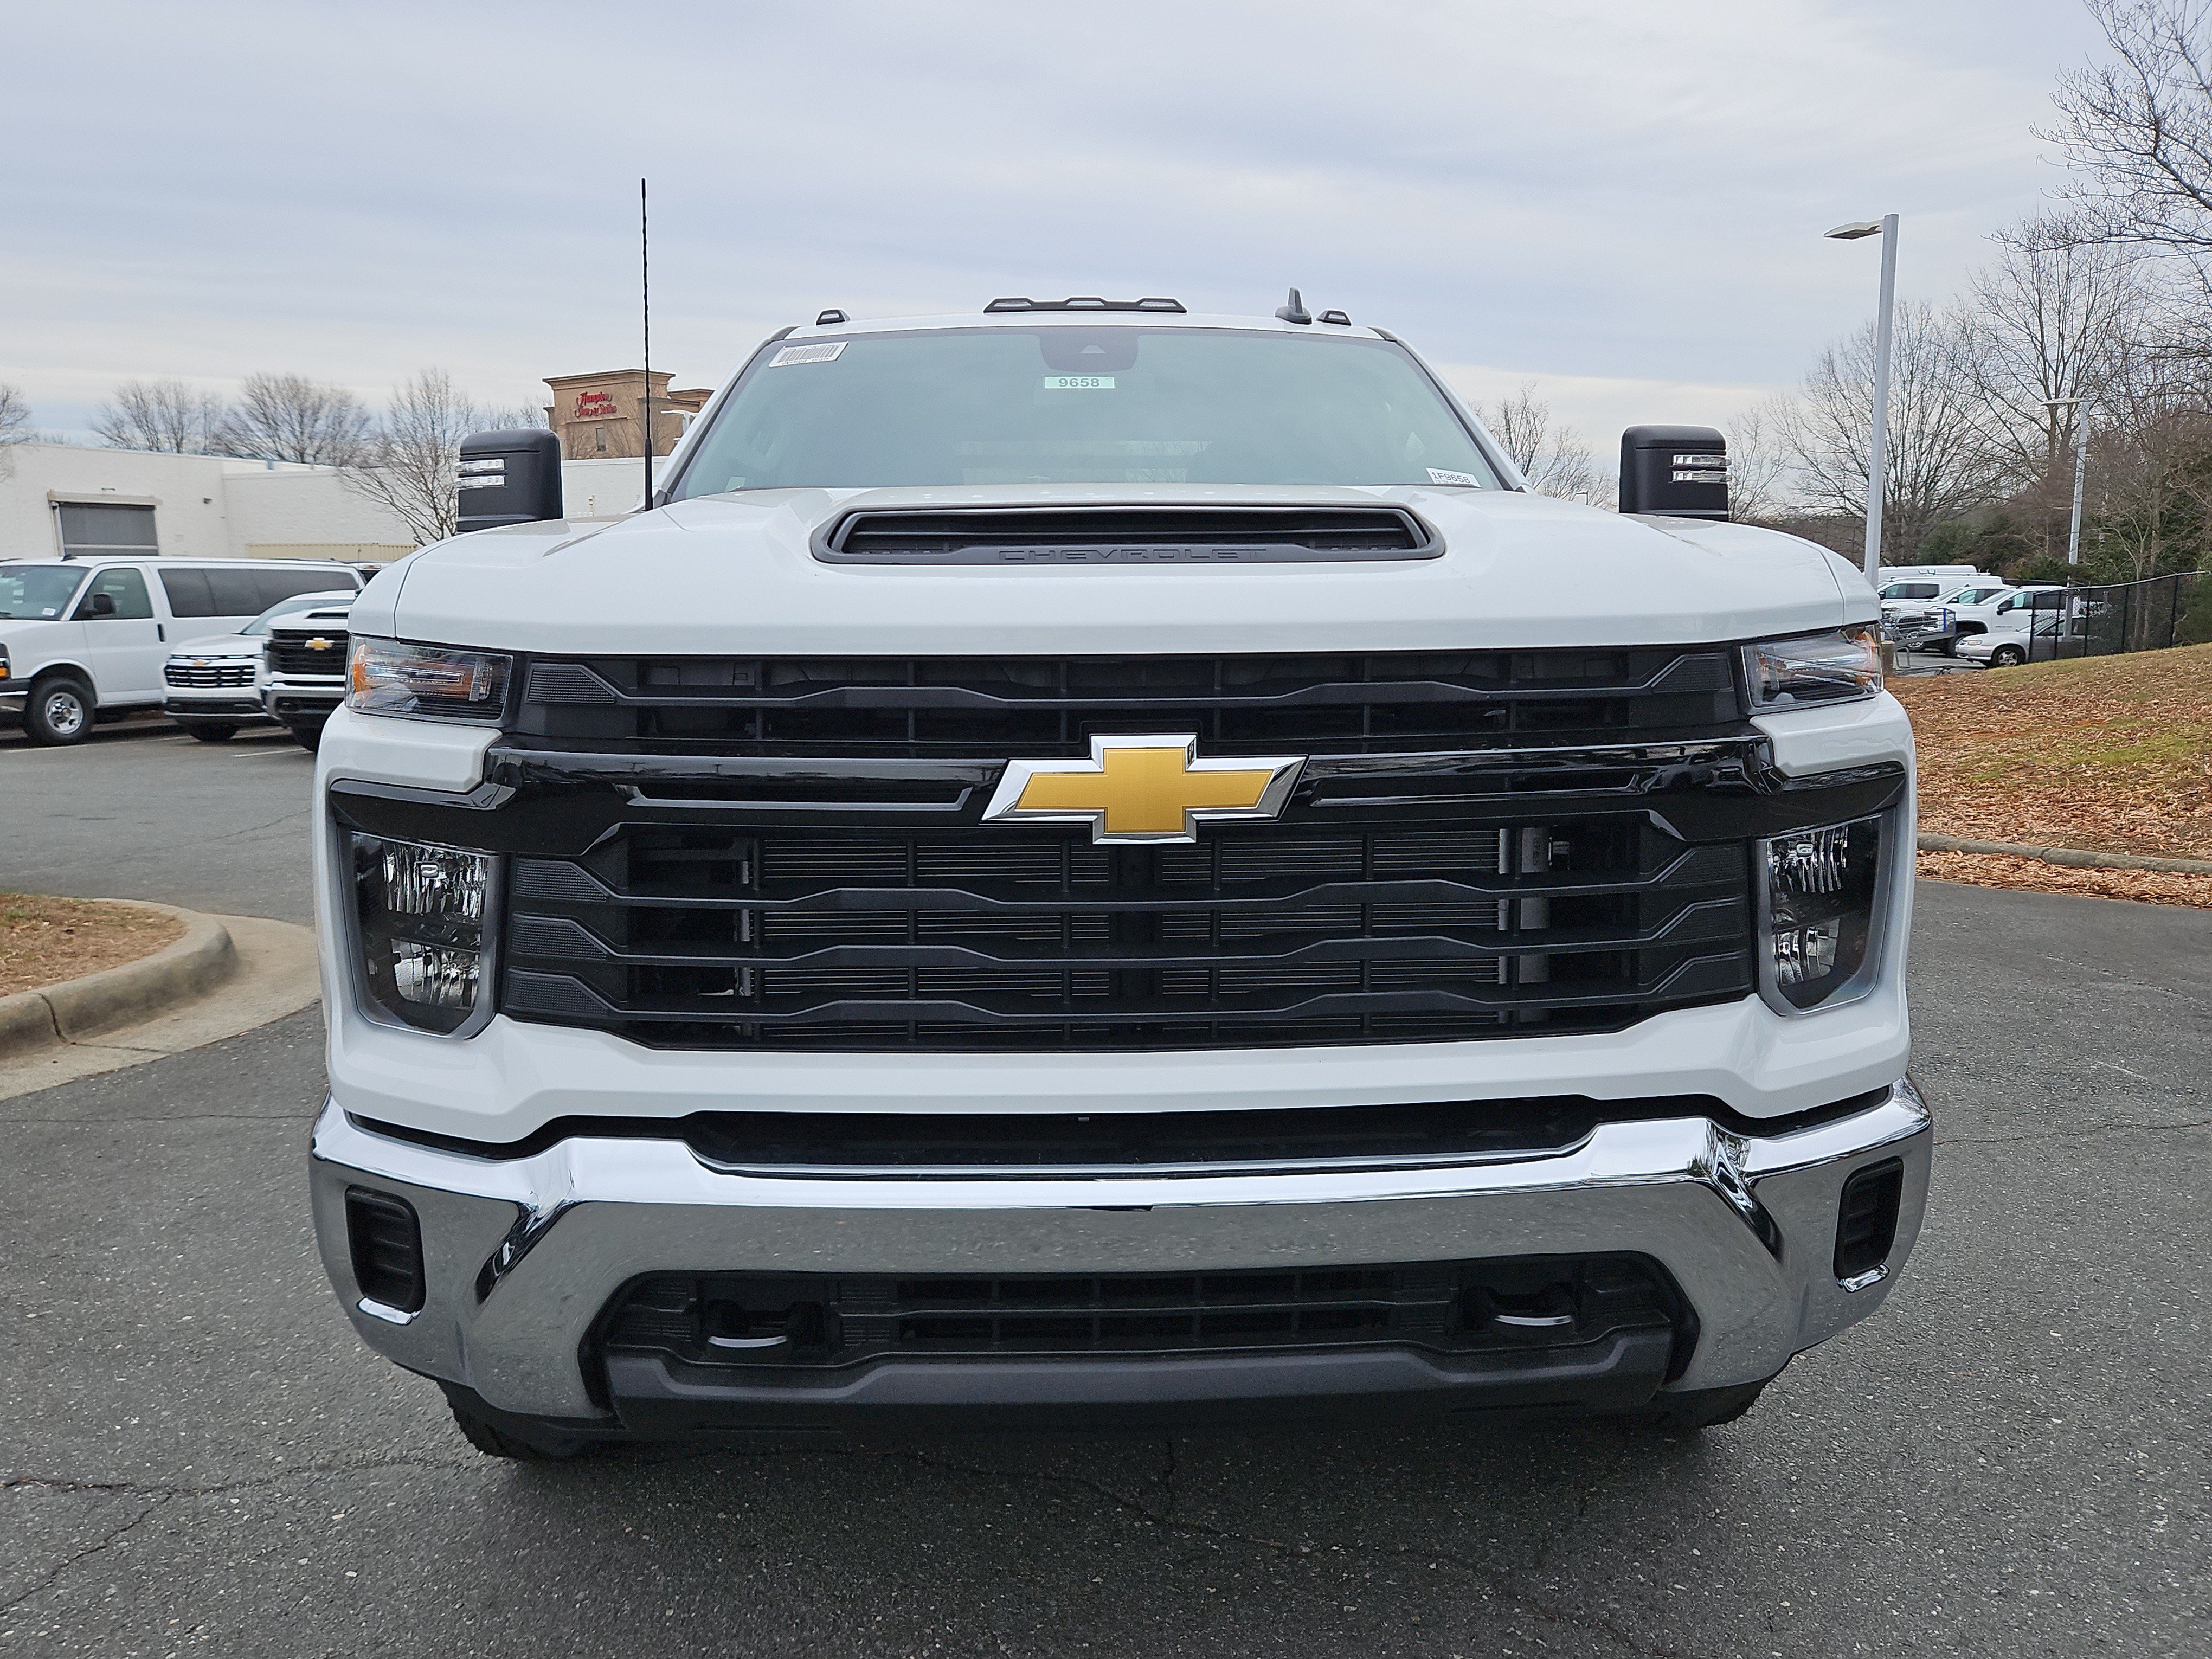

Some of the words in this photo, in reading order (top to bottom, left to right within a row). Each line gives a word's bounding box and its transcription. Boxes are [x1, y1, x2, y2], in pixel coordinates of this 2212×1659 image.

[1058, 377, 1100, 387] 9658
[576, 391, 613, 407] Hampton
[1431, 472, 1470, 484] 1F9658
[999, 549, 1266, 560] CHEVROLET
